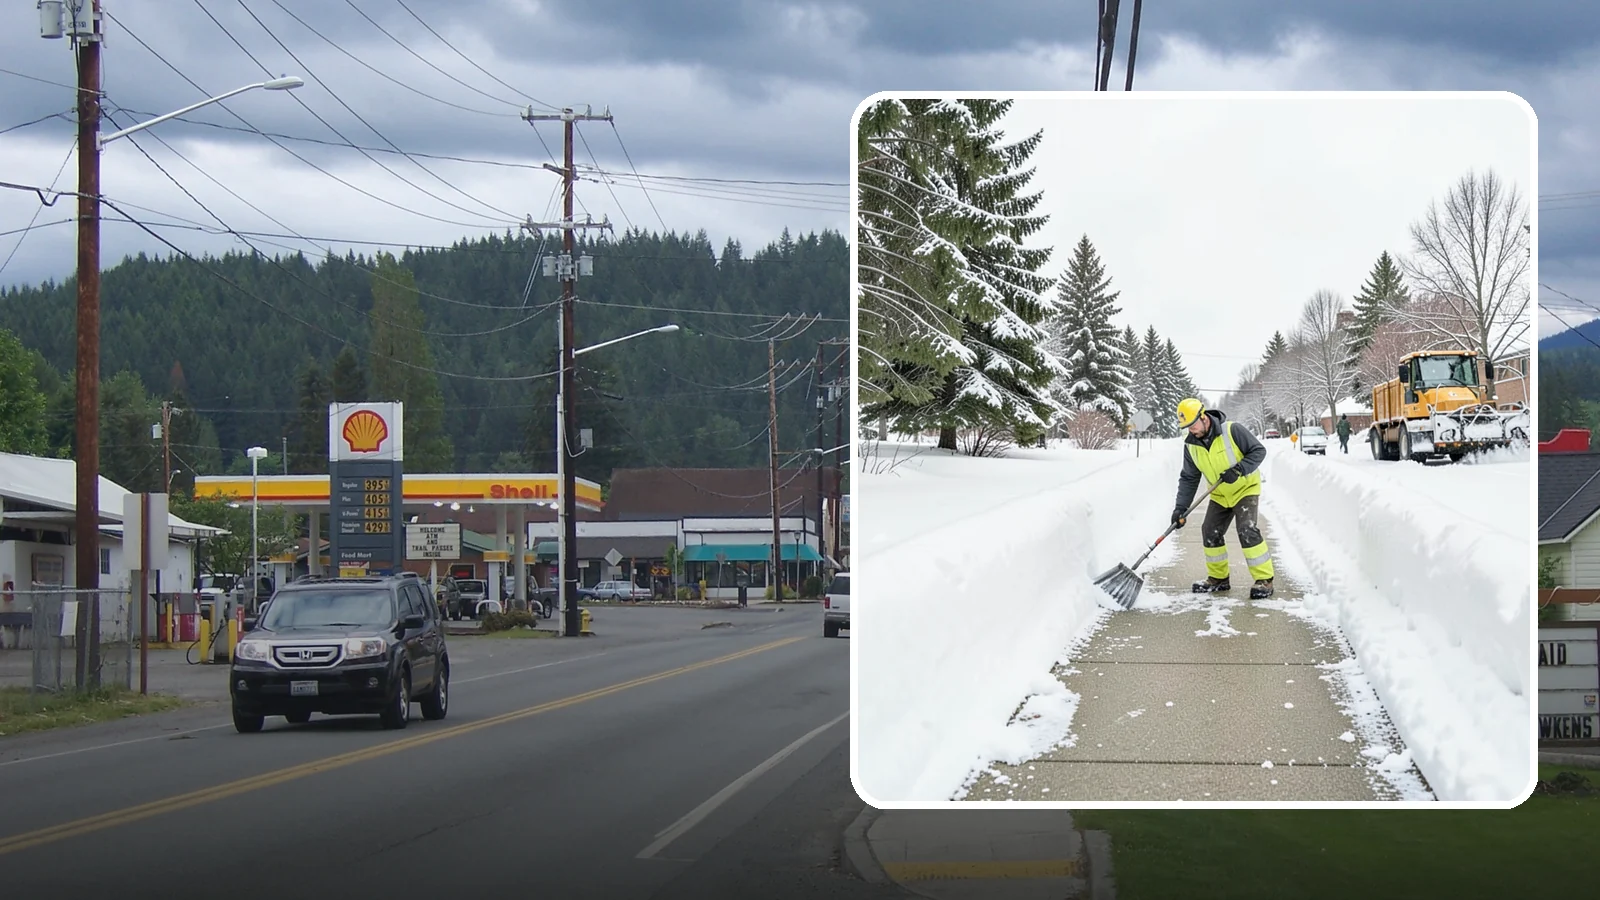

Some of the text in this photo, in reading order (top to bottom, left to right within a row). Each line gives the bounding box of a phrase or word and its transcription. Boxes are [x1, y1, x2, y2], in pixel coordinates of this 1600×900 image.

[365, 480, 384, 490] 395
[490, 484, 547, 499] Shell
[365, 494, 384, 504] 405
[365, 508, 384, 518] 415
[365, 522, 384, 532] 429
